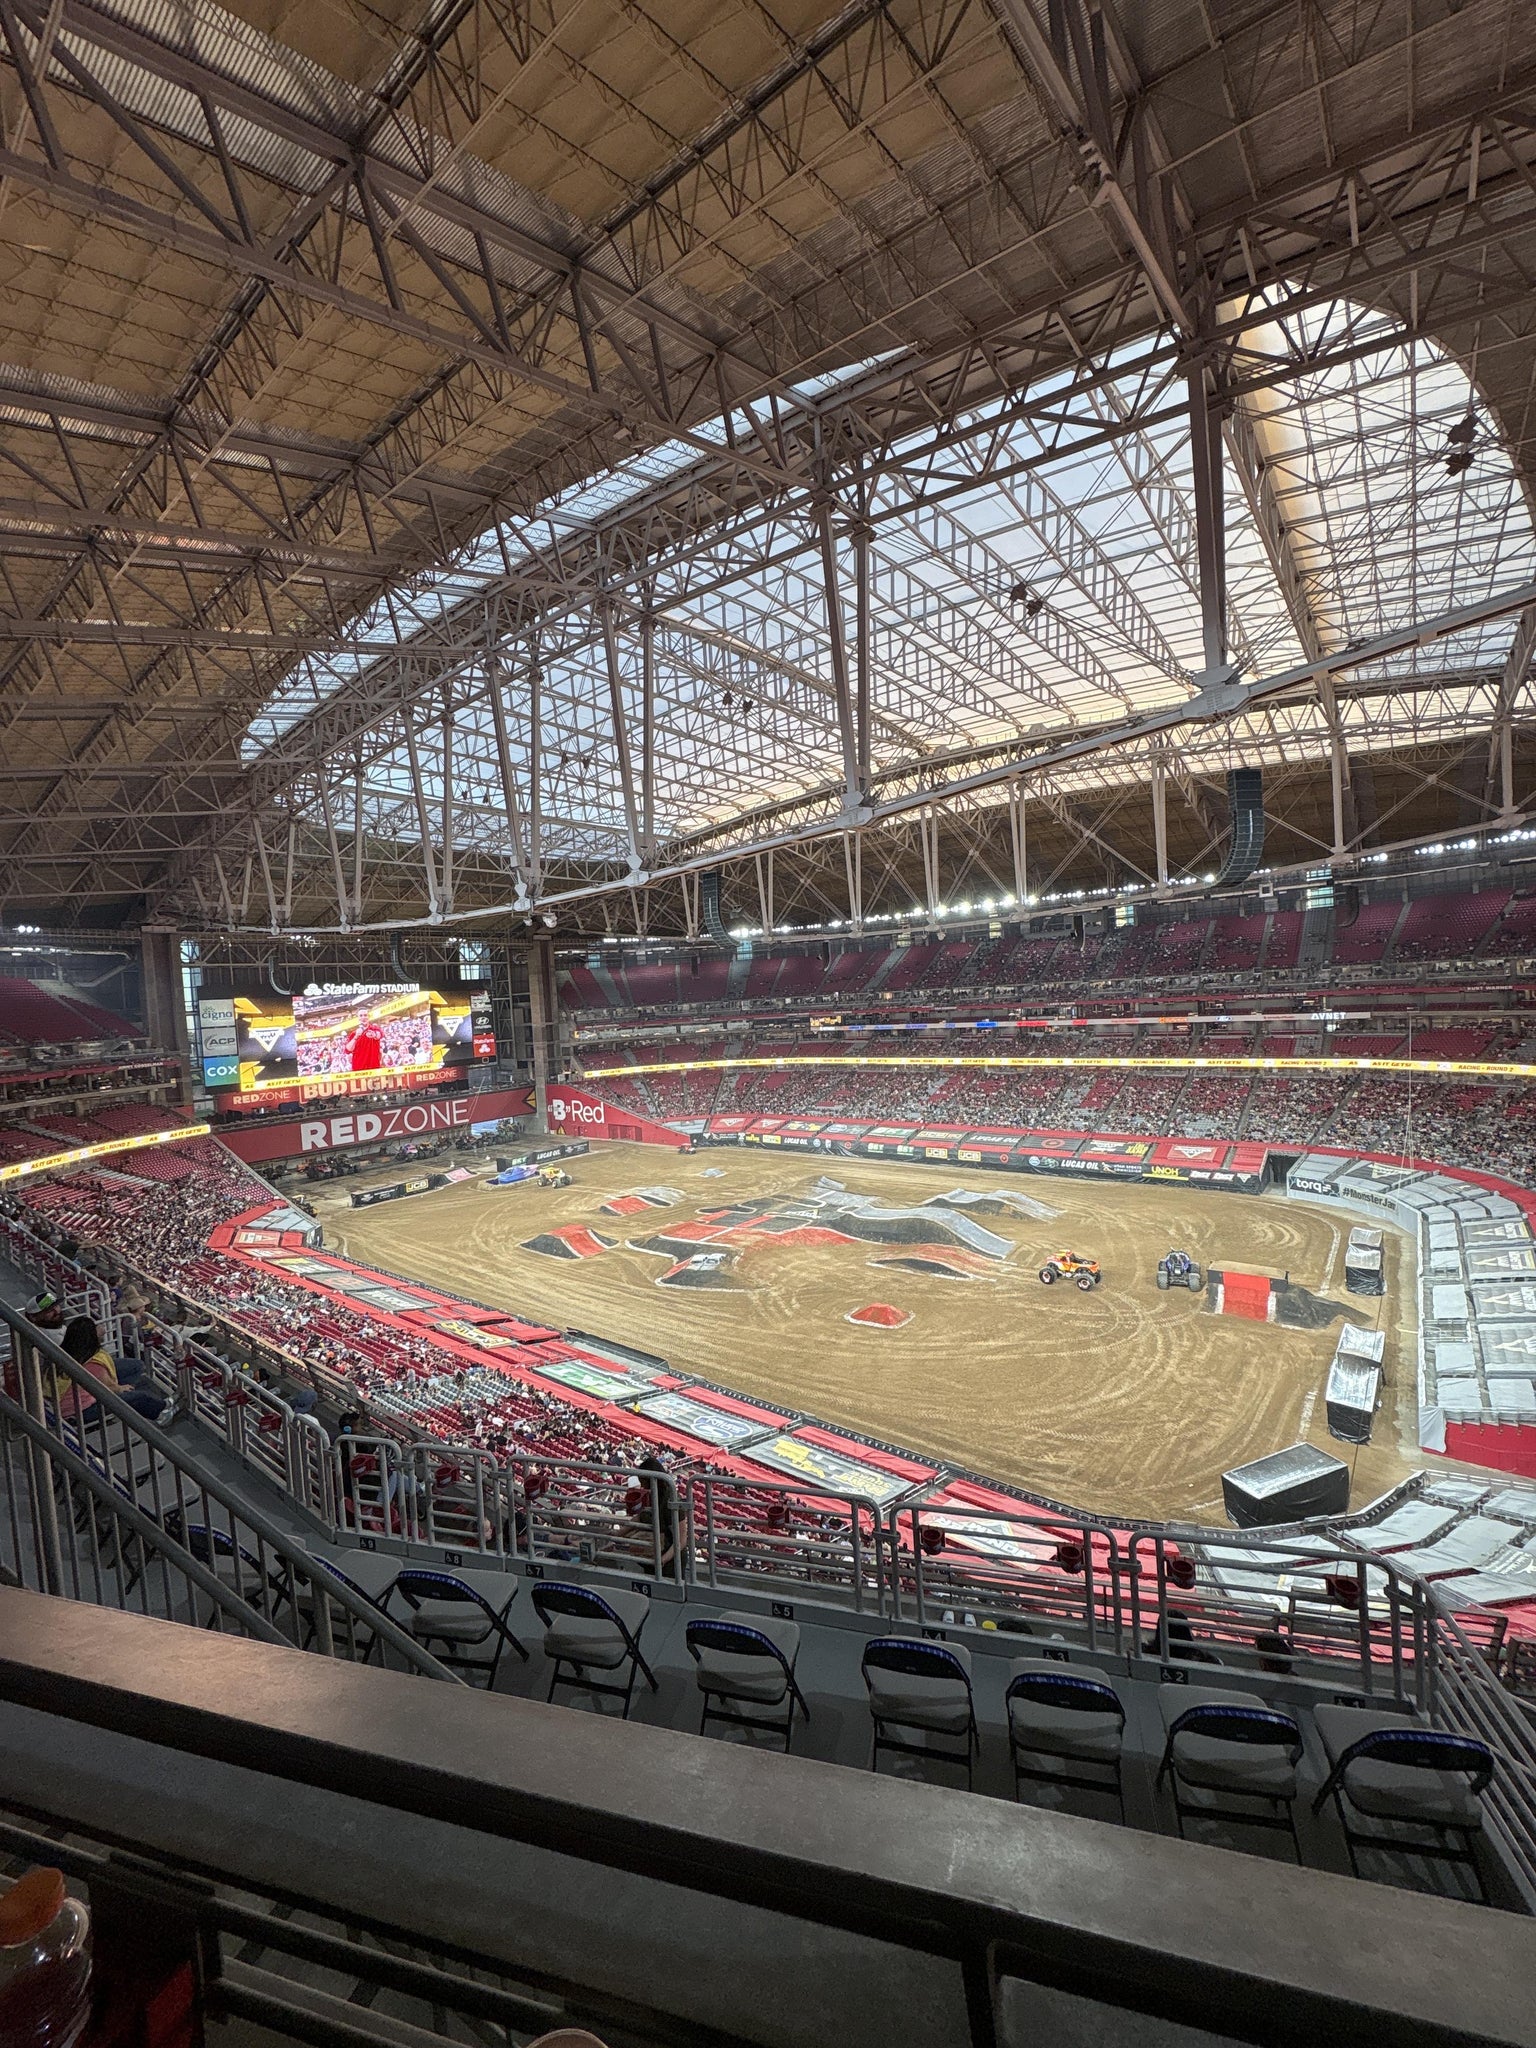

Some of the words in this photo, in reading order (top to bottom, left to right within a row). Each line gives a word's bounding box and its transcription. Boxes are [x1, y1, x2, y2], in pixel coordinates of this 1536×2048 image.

[380, 984, 419, 994] STADIUM
[201, 1009, 233, 1021] cigna
[1311, 1012, 1346, 1020] AVNET
[209, 1037, 235, 1046] ACP
[206, 1065, 238, 1077] COX
[416, 1069, 458, 1082] REDZONE
[303, 1080, 348, 1099] BUD
[350, 1075, 405, 1093] LIGHT
[232, 1089, 291, 1105] REDZONE
[571, 1100, 605, 1124] Red
[300, 1099, 470, 1151] REDZONE
[928, 1149, 946, 1158] JCB
[961, 1152, 980, 1160] JCB
[1061, 1159, 1086, 1169] LUCAS
[1086, 1161, 1099, 1170] OIL
[1151, 1165, 1179, 1176] UNOH
[408, 1179, 427, 1192] JCB
[453, 1555, 459, 1564] 8
[535, 1567, 541, 1575] 7
[642, 1585, 648, 1594] 6
[783, 1608, 790, 1617] 5
[935, 1632, 942, 1641] 4
[1057, 1652, 1065, 1662] 3
[1175, 1673, 1184, 1683] 2
